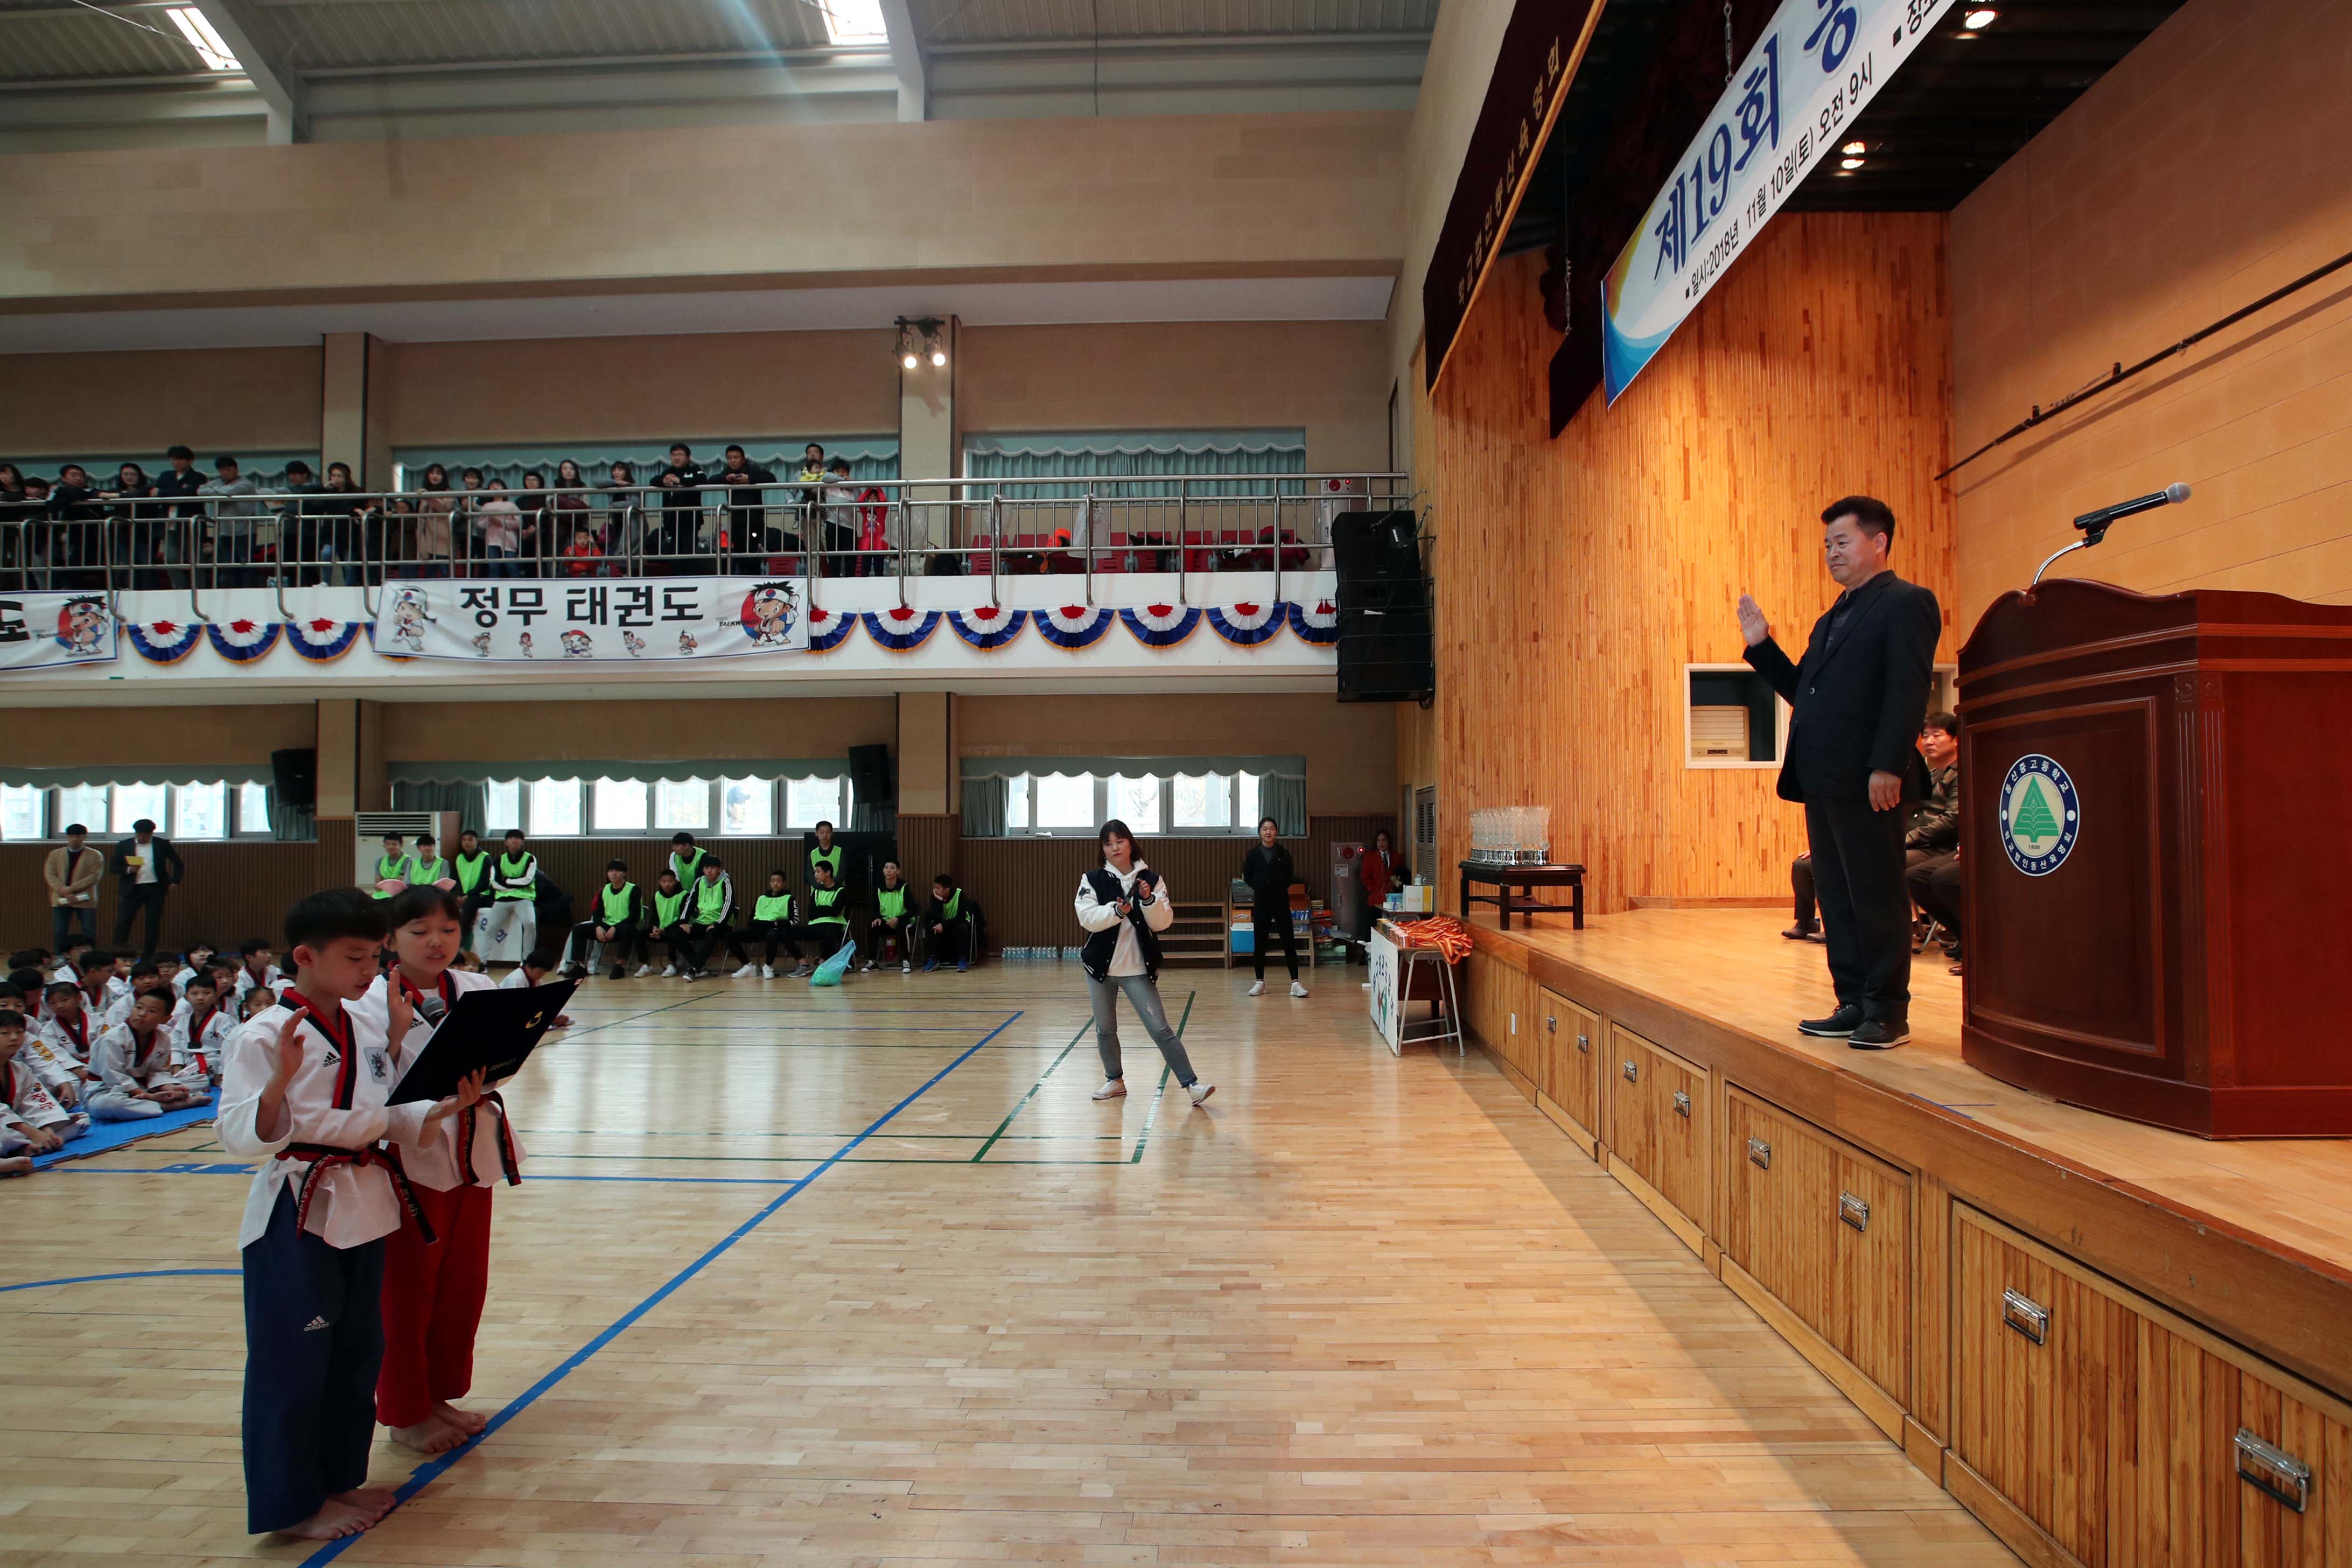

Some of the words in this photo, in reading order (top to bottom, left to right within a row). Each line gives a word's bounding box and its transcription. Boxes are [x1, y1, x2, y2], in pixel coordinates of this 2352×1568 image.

[1654, 32, 1778, 281] 제19회
[1746, 184, 1767, 229] 11월
[1770, 127, 1814, 200] 10일(토)
[1819, 87, 1844, 143] 오전
[1850, 51, 1872, 105] 9시
[460, 586, 548, 627] 정무
[566, 585, 704, 627] 태권도
[2005, 760, 2069, 795] 동산중고등학교
[2004, 830, 2073, 871] 학교법인동산육영회
[304, 1322, 330, 1331] adidas
